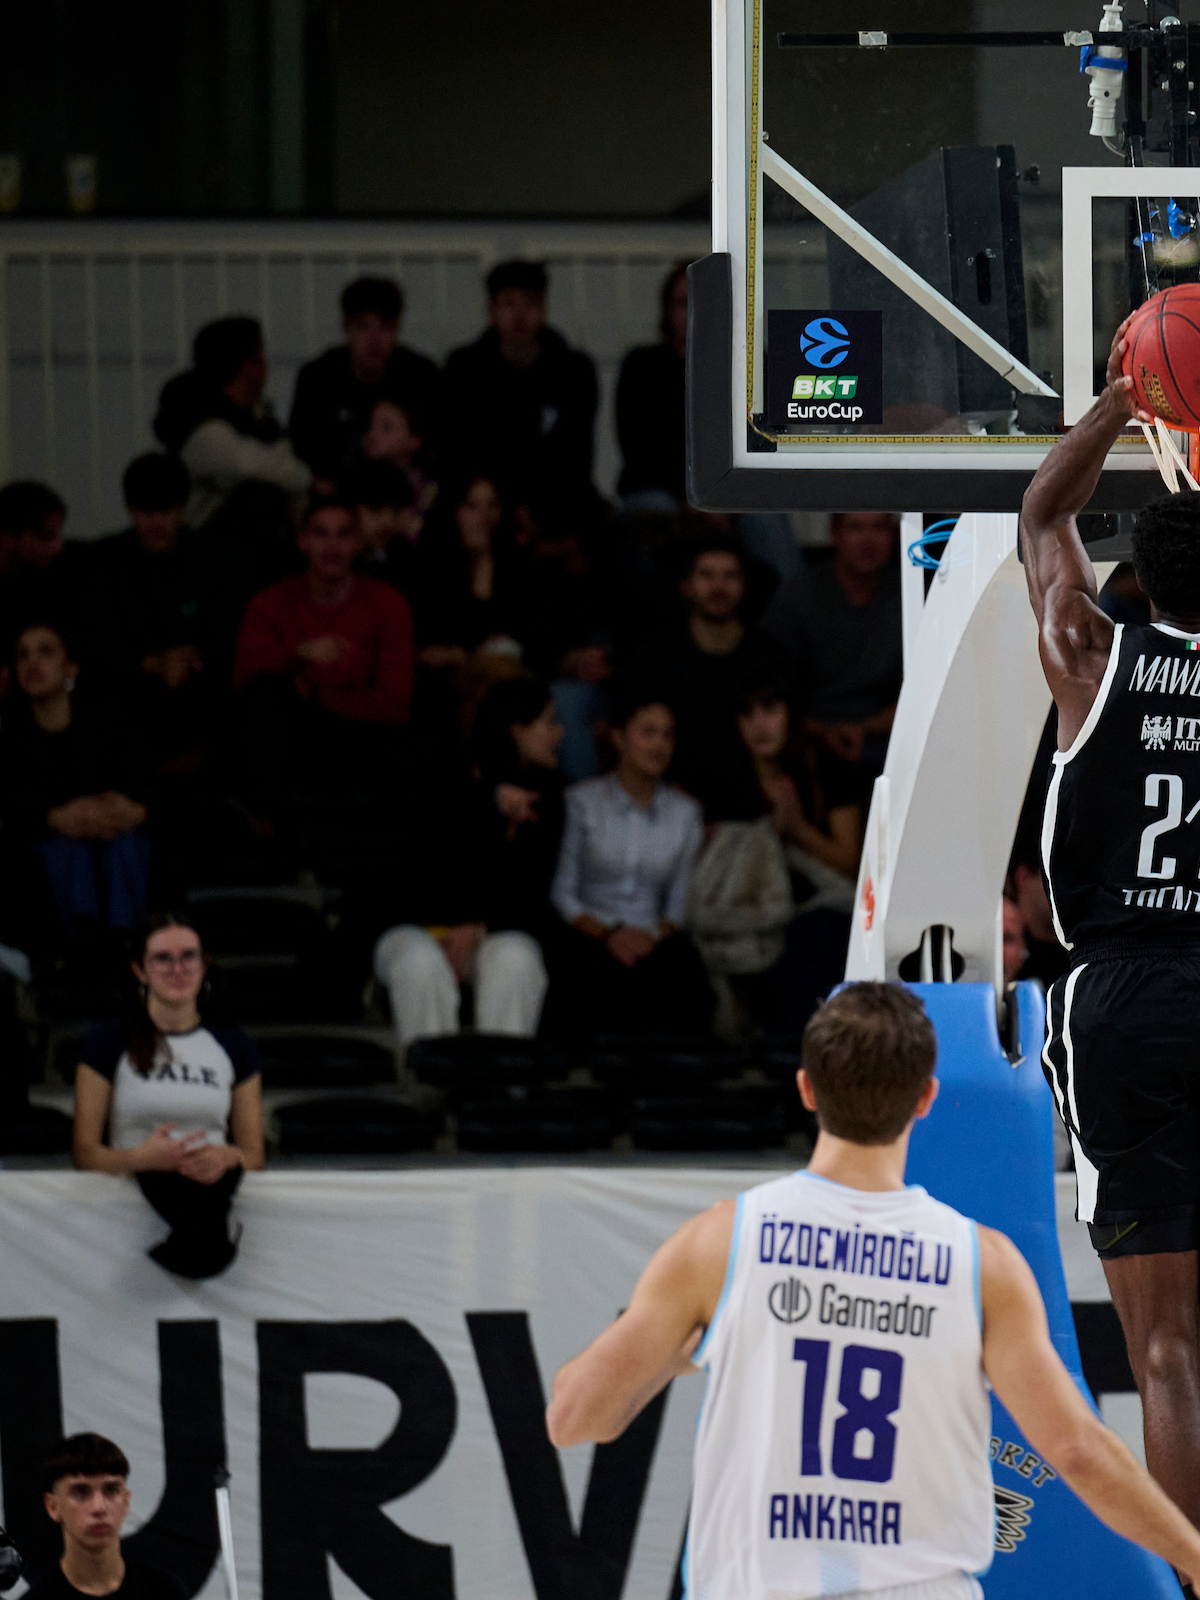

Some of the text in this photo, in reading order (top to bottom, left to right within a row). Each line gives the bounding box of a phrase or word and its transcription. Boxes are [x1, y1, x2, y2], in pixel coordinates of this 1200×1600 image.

[787, 402, 864, 422] EuroCup
[794, 379, 856, 395] BKT
[138, 1063, 219, 1088] ALE
[759, 1214, 951, 1285] ÖZDEMİROĞLU
[820, 1283, 937, 1338] Gamador
[793, 1337, 905, 1484] 18
[0, 1309, 692, 1600] URV
[769, 1494, 902, 1545] ANKARA
